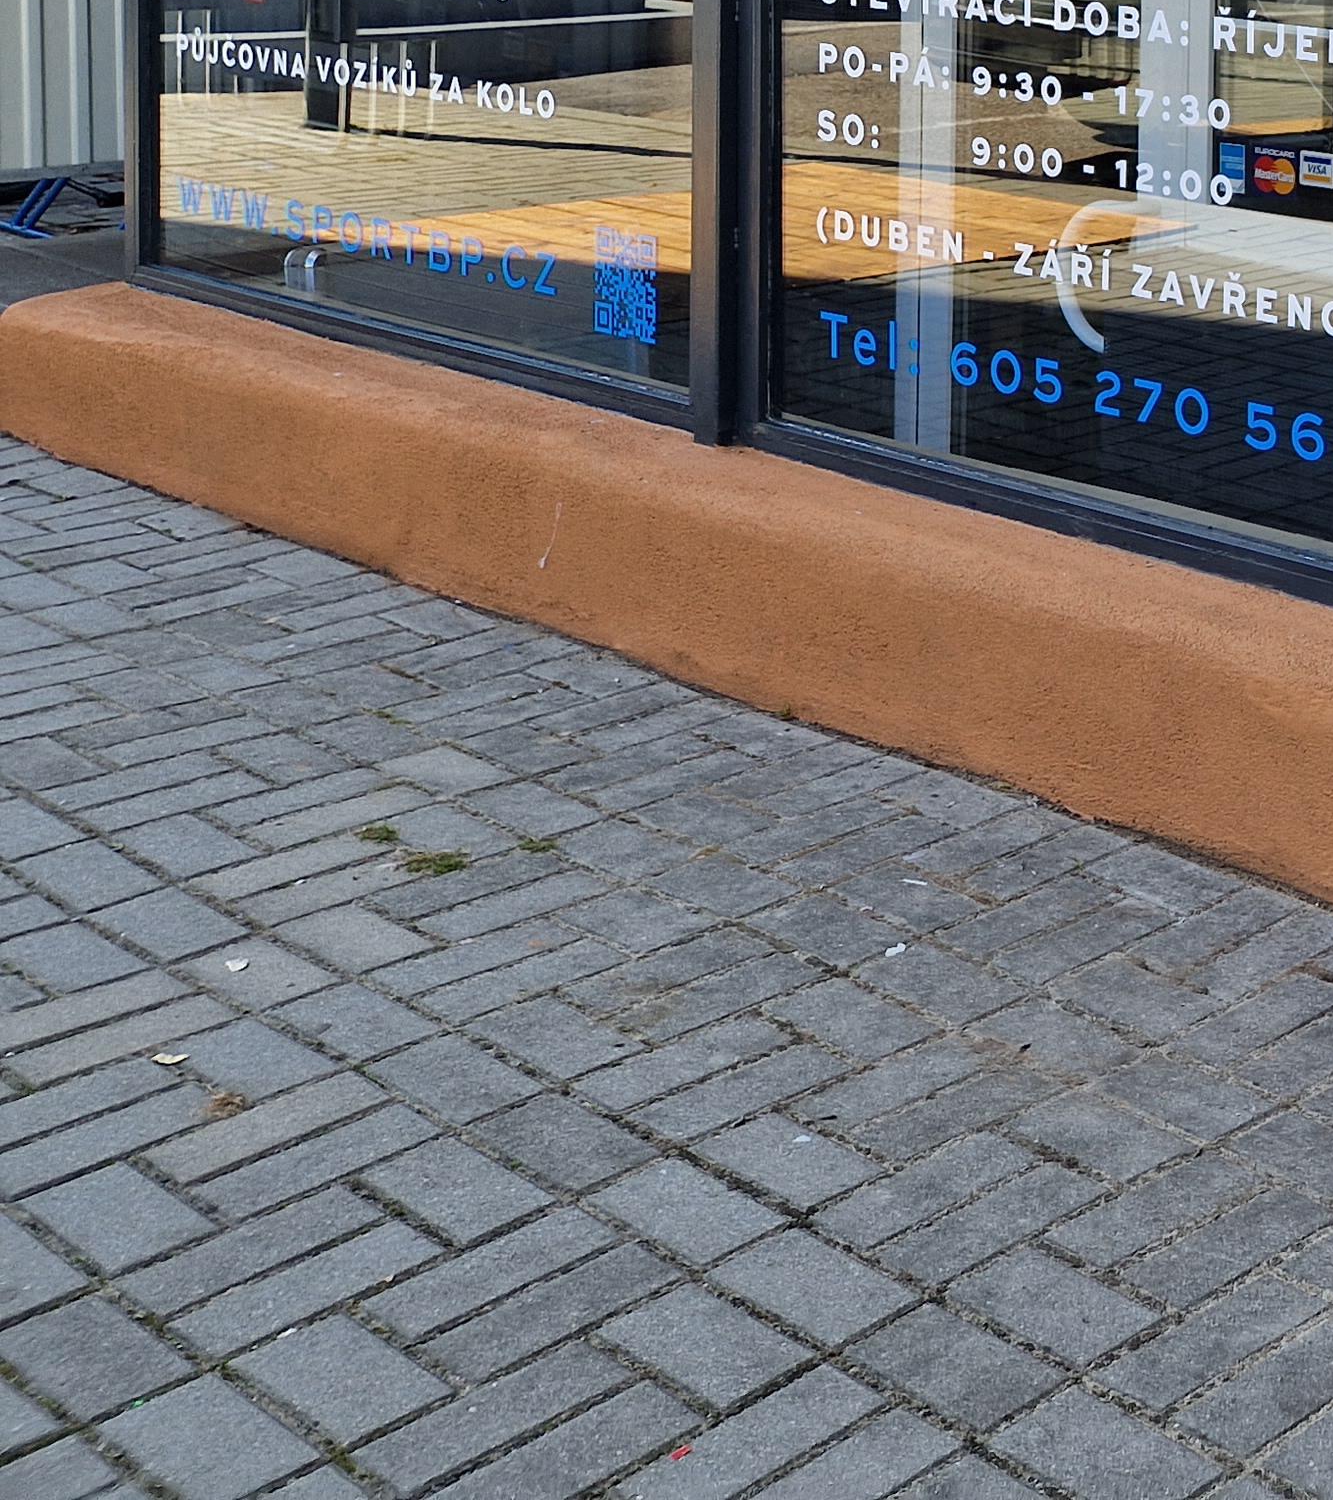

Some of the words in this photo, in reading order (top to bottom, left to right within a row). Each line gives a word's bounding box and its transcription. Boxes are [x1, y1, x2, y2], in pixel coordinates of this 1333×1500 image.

[175, 27, 306, 79] PŮJČOVNA
[317, 55, 416, 98] VOZÍKŮ
[429, 73, 464, 105] ZA
[477, 80, 555, 119] KOLO
[818, 43, 949, 90] PO-PÁ:
[971, 66, 1061, 106] 9:30
[1082, 91, 1095, 100] -
[1114, 85, 1231, 130] 17:30
[817, 109, 881, 149] SO:
[971, 136, 1063, 178] 9:00
[1082, 164, 1095, 175] -
[1115, 159, 1233, 206] 12:00
[1254, 146, 1295, 159] EUROCARD
[1254, 168, 1295, 183] MasterCard
[1307, 164, 1327, 175] VISA
[176, 175, 560, 297] WWW.SPORTBP.CZ
[815, 205, 964, 263] (DUBEN
[982, 249, 995, 260] -
[1013, 238, 1111, 291] ZÁŘÍ
[819, 310, 920, 376] Tel:
[950, 341, 1063, 405] 605
[1094, 370, 1210, 436] 270
